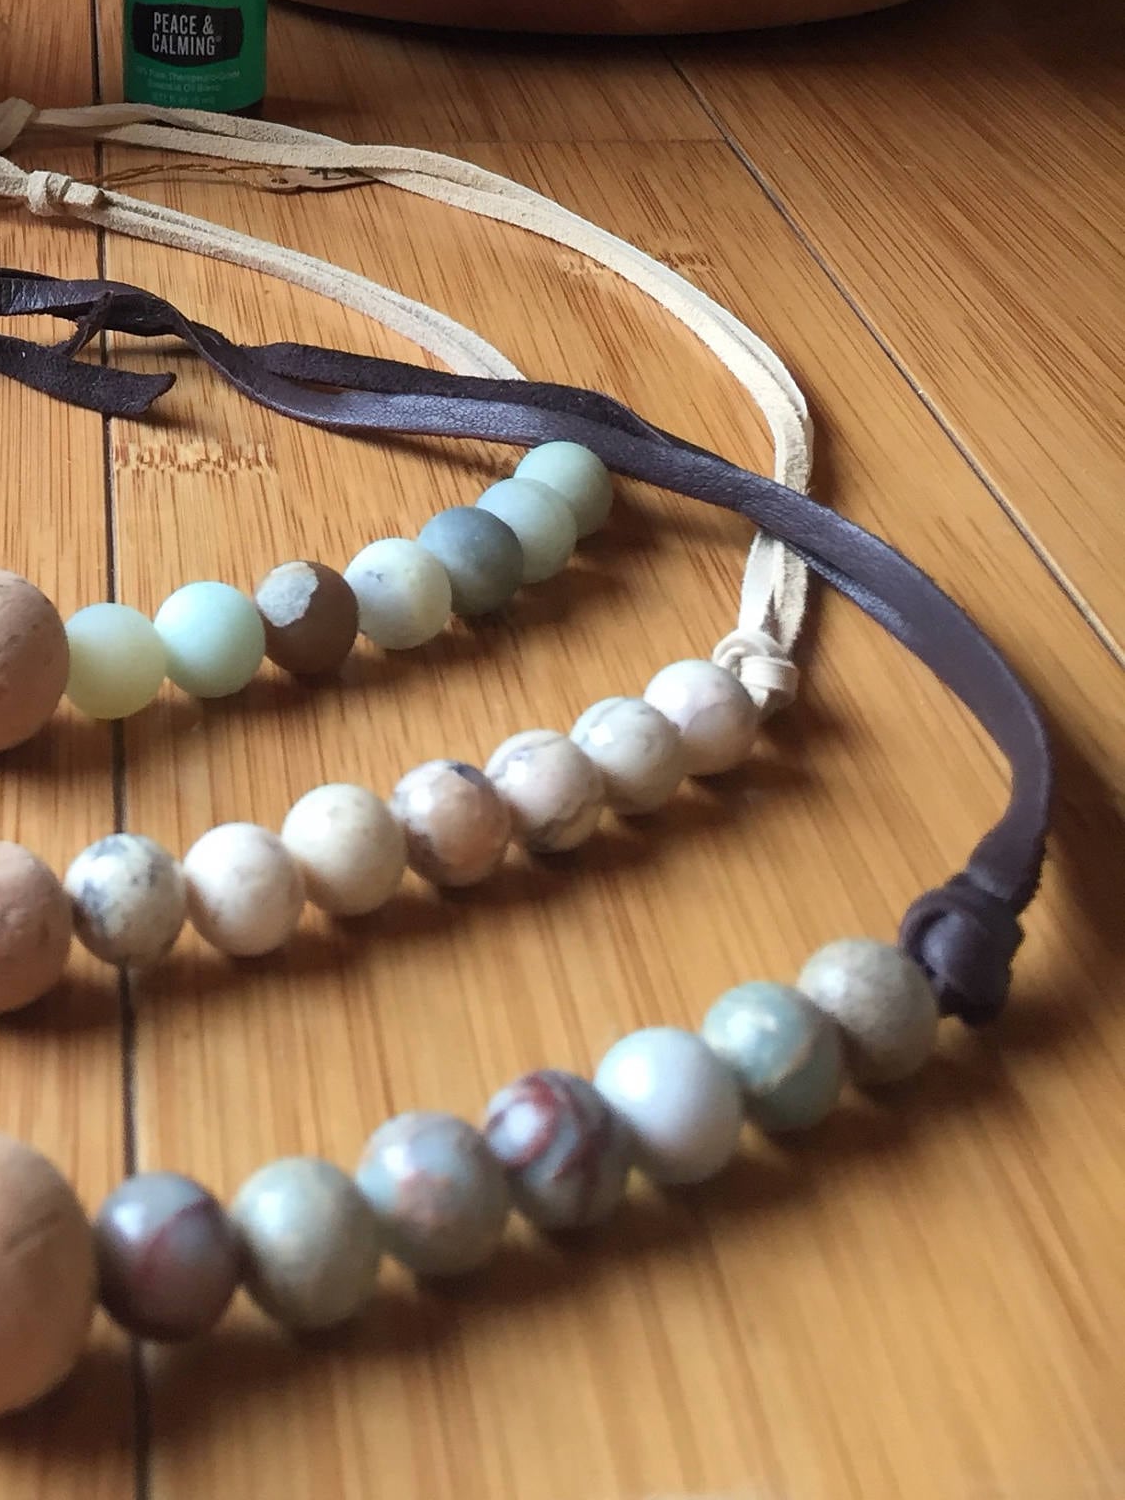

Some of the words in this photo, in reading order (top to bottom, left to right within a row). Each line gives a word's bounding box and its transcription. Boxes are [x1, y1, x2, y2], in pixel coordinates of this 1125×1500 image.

[153, 11, 197, 35] PEACE
[202, 14, 215, 36] &
[151, 32, 216, 57] CALMING
